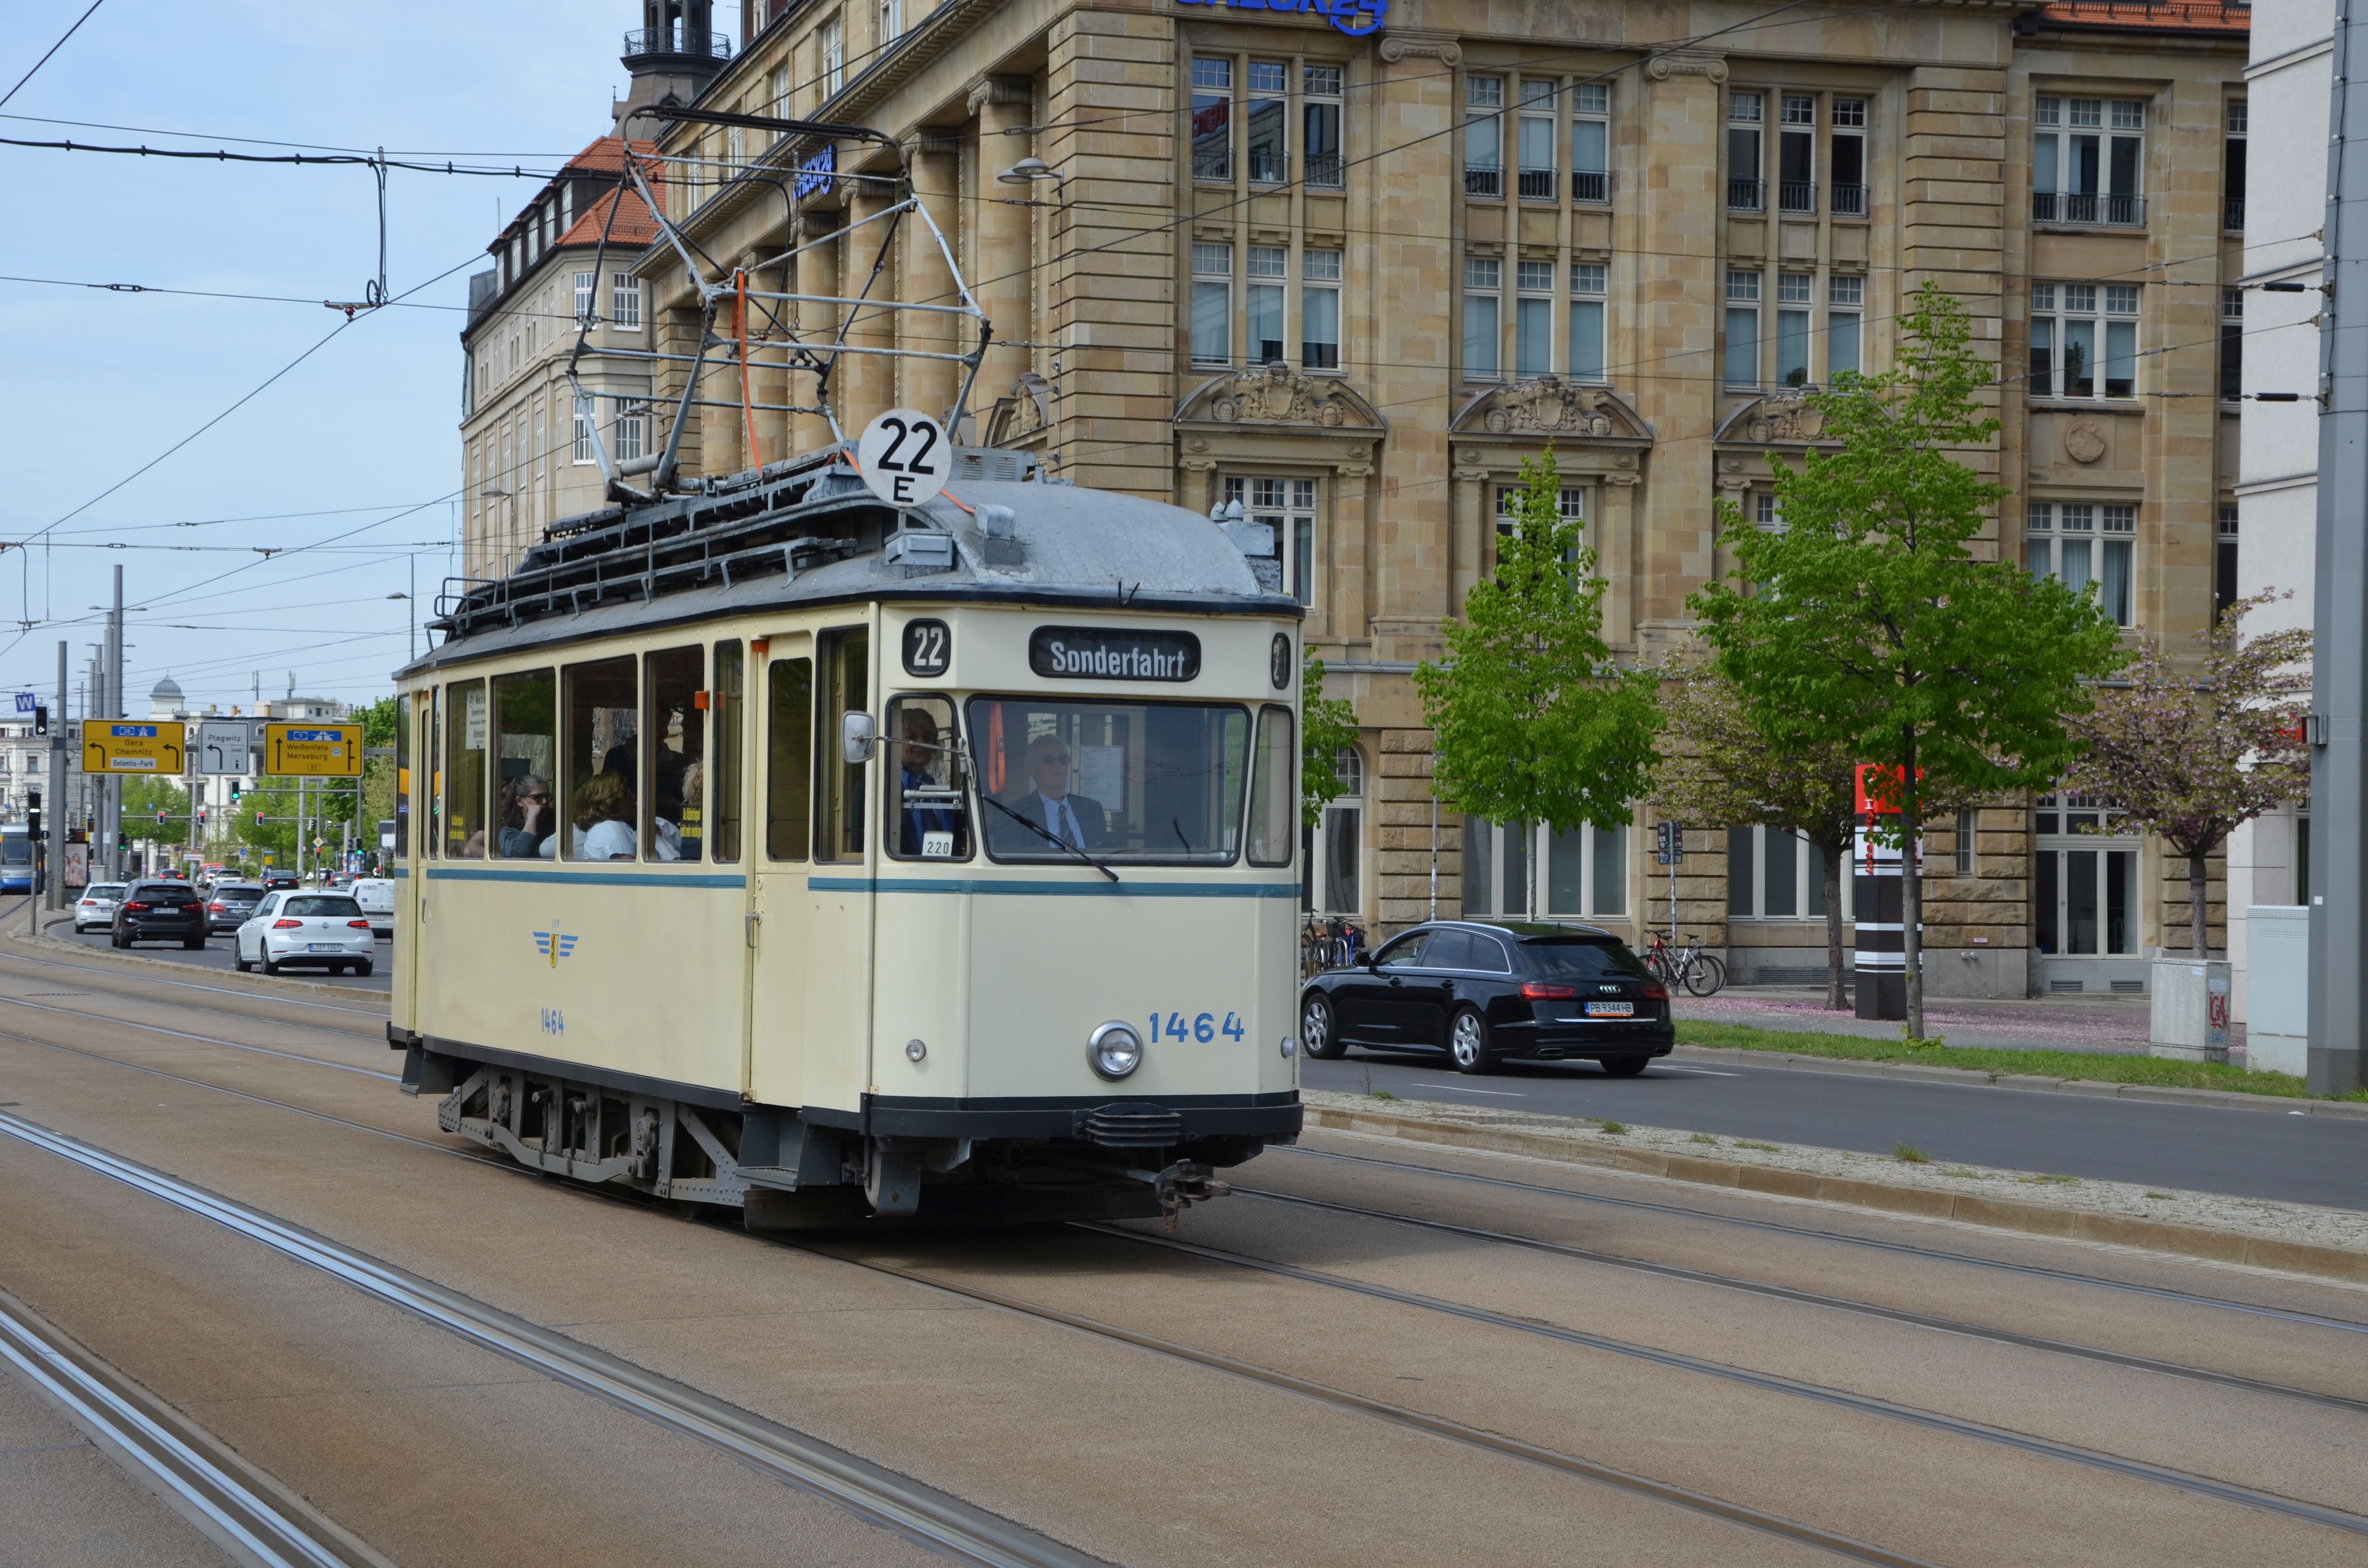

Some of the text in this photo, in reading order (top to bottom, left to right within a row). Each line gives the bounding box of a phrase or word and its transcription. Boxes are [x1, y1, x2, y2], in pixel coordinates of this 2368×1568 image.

[878, 417, 937, 475] 22
[893, 476, 915, 503] E
[914, 627, 943, 666] 22
[1050, 642, 1184, 677] Sonderfahrt
[17, 696, 33, 710] W
[287, 753, 327, 761] Merseburg
[927, 841, 949, 854] 220
[542, 1007, 564, 1036] 1464
[1590, 1004, 1632, 1012] PB 9344 HB
[1149, 1012, 1245, 1043] 1464
